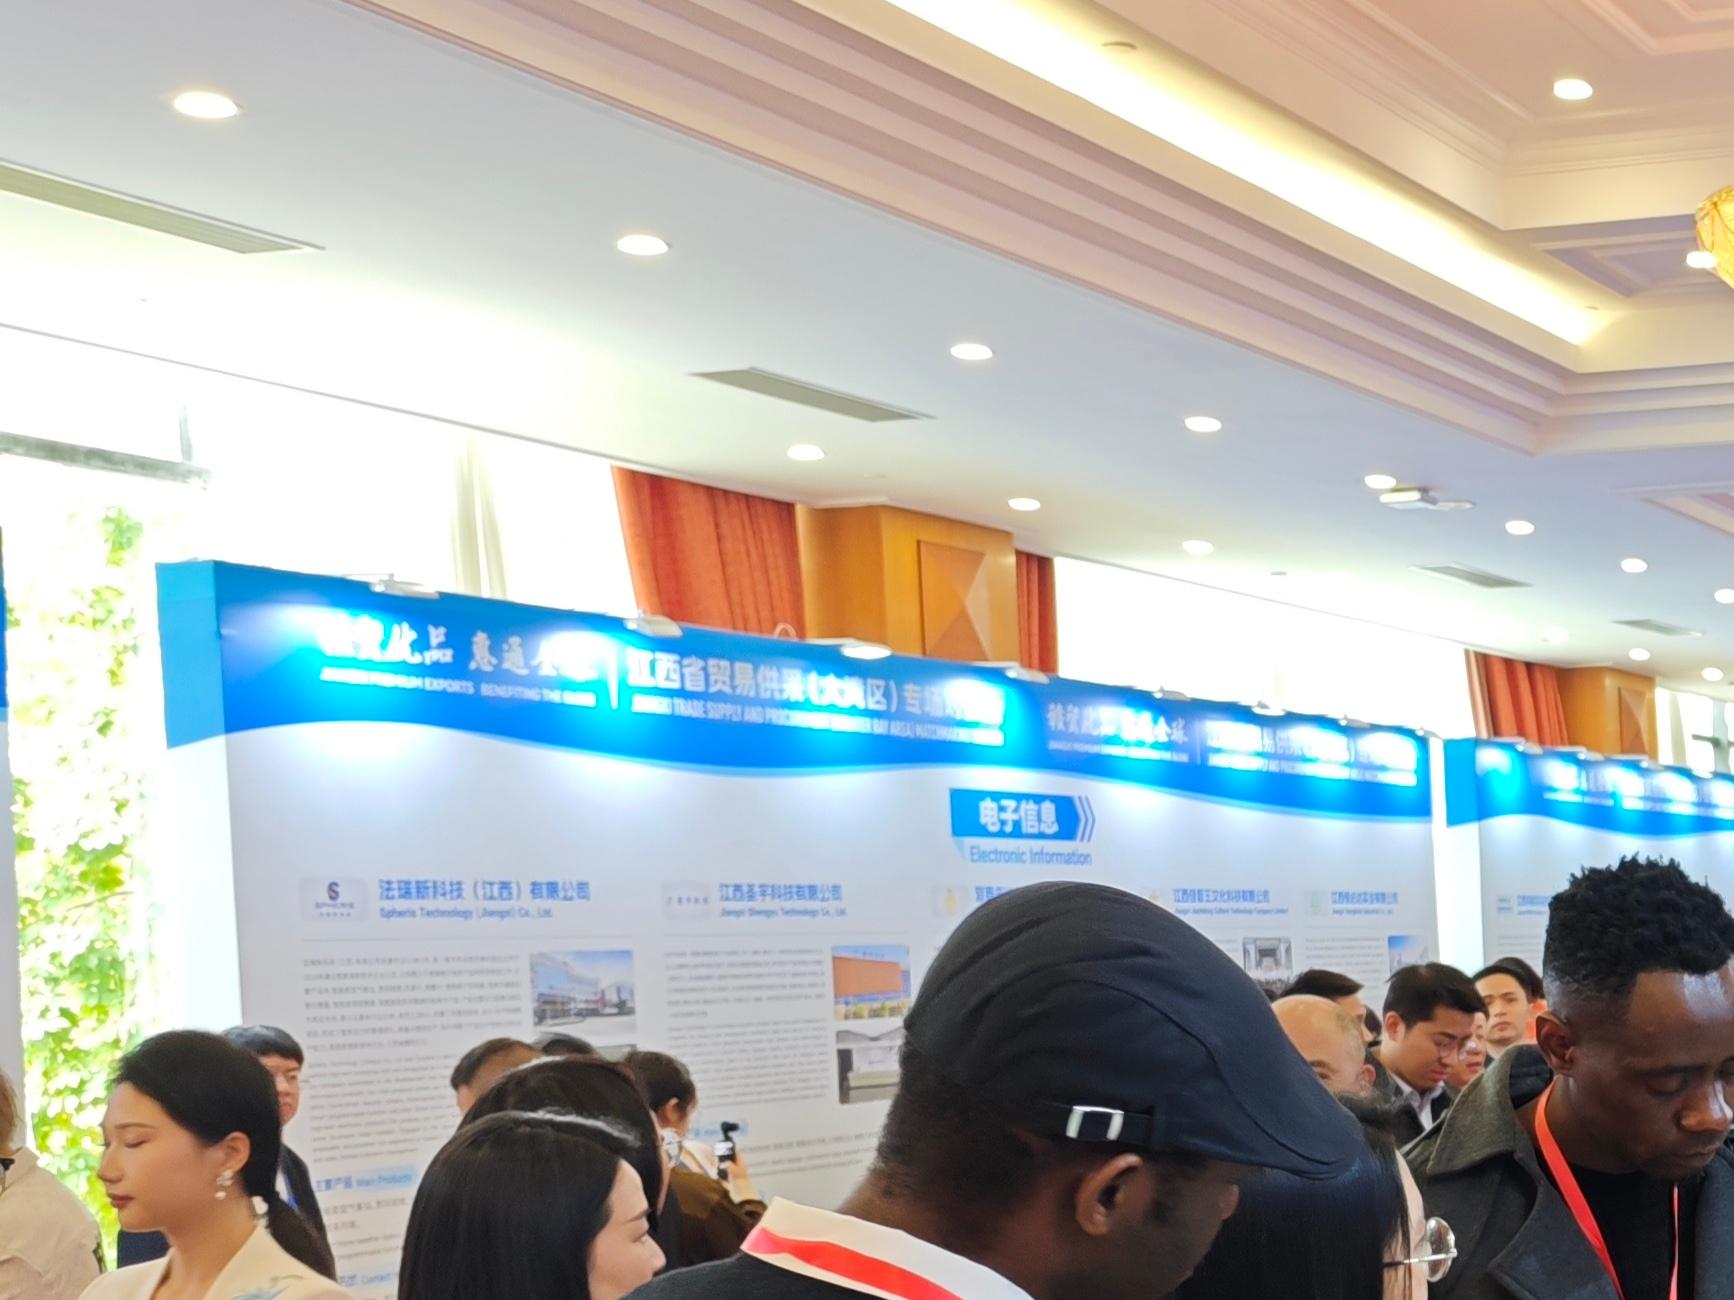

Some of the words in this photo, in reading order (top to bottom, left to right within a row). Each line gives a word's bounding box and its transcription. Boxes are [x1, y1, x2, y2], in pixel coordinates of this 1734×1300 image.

[979, 797, 1060, 835] 电子信息
[970, 846, 1027, 864] Electronic
[1030, 848, 1093, 867] Information
